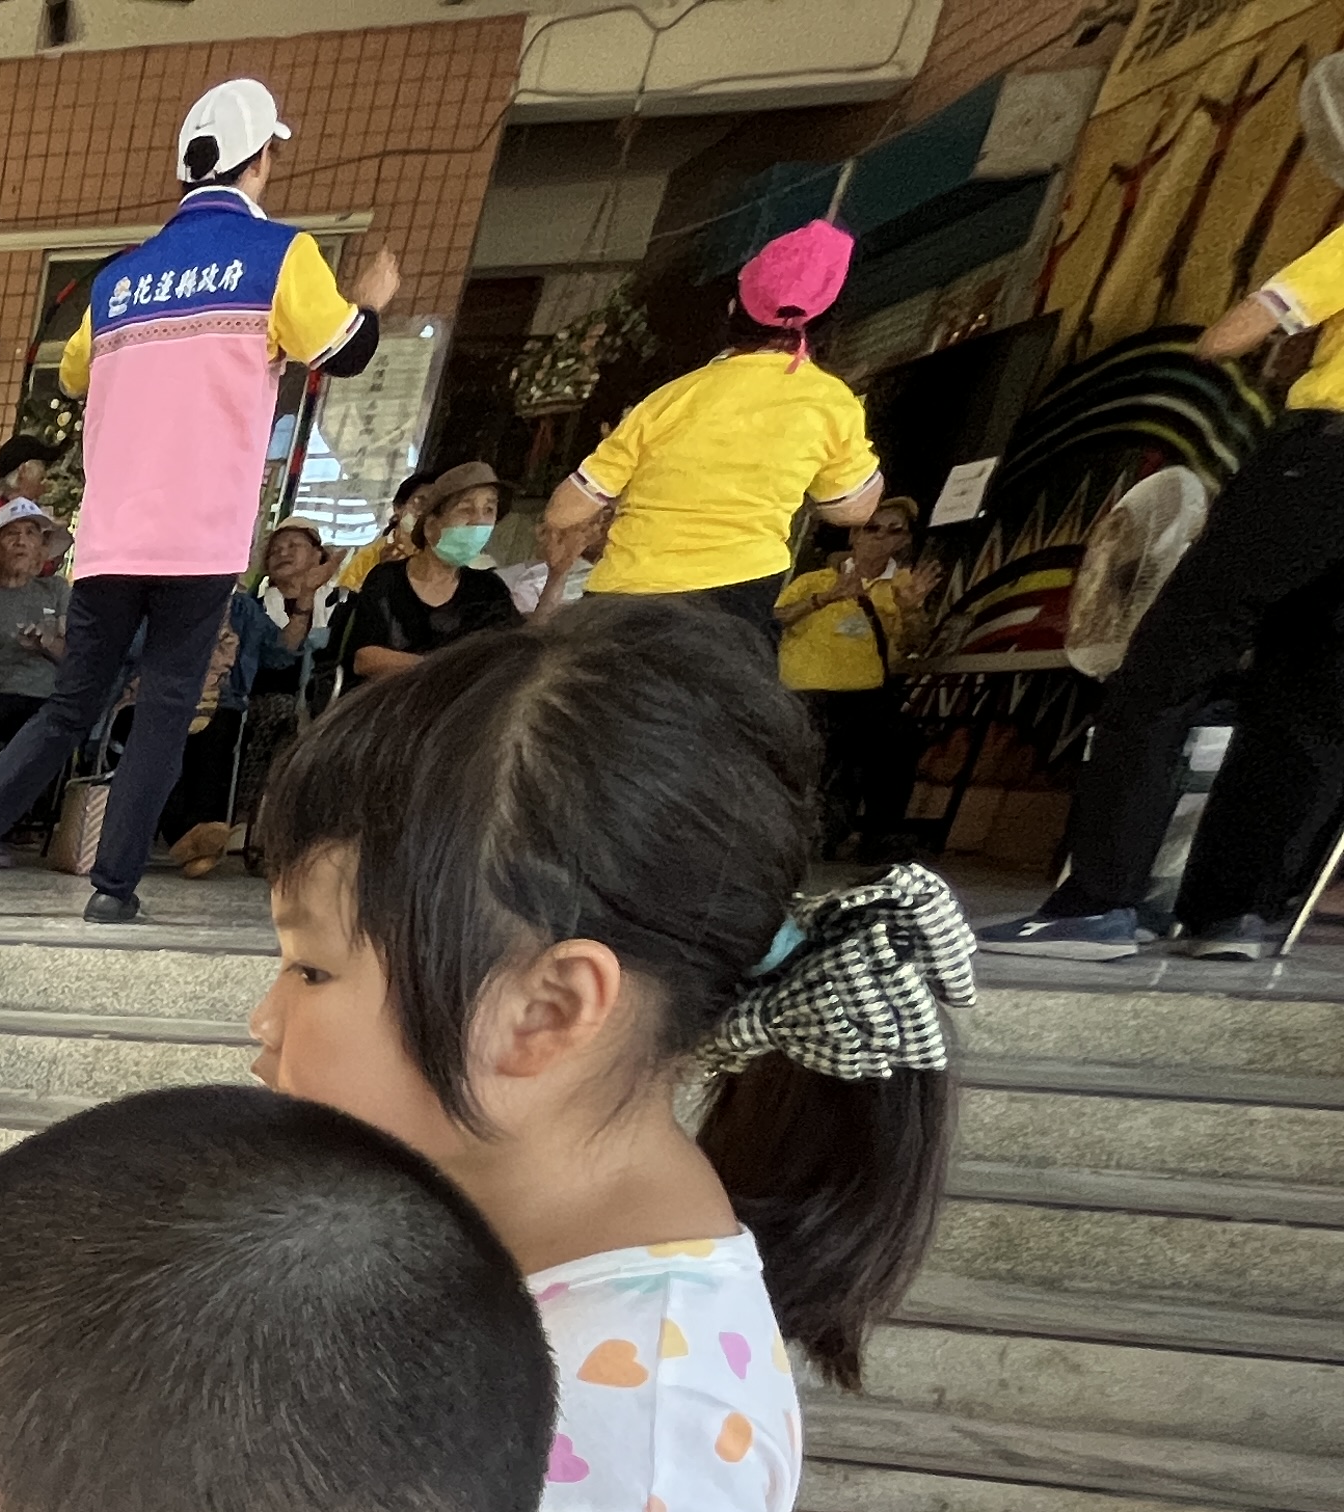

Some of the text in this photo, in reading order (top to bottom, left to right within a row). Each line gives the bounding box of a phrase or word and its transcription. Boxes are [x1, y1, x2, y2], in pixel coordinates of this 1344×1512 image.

[133, 259, 243, 305] 花蓮縣政府
